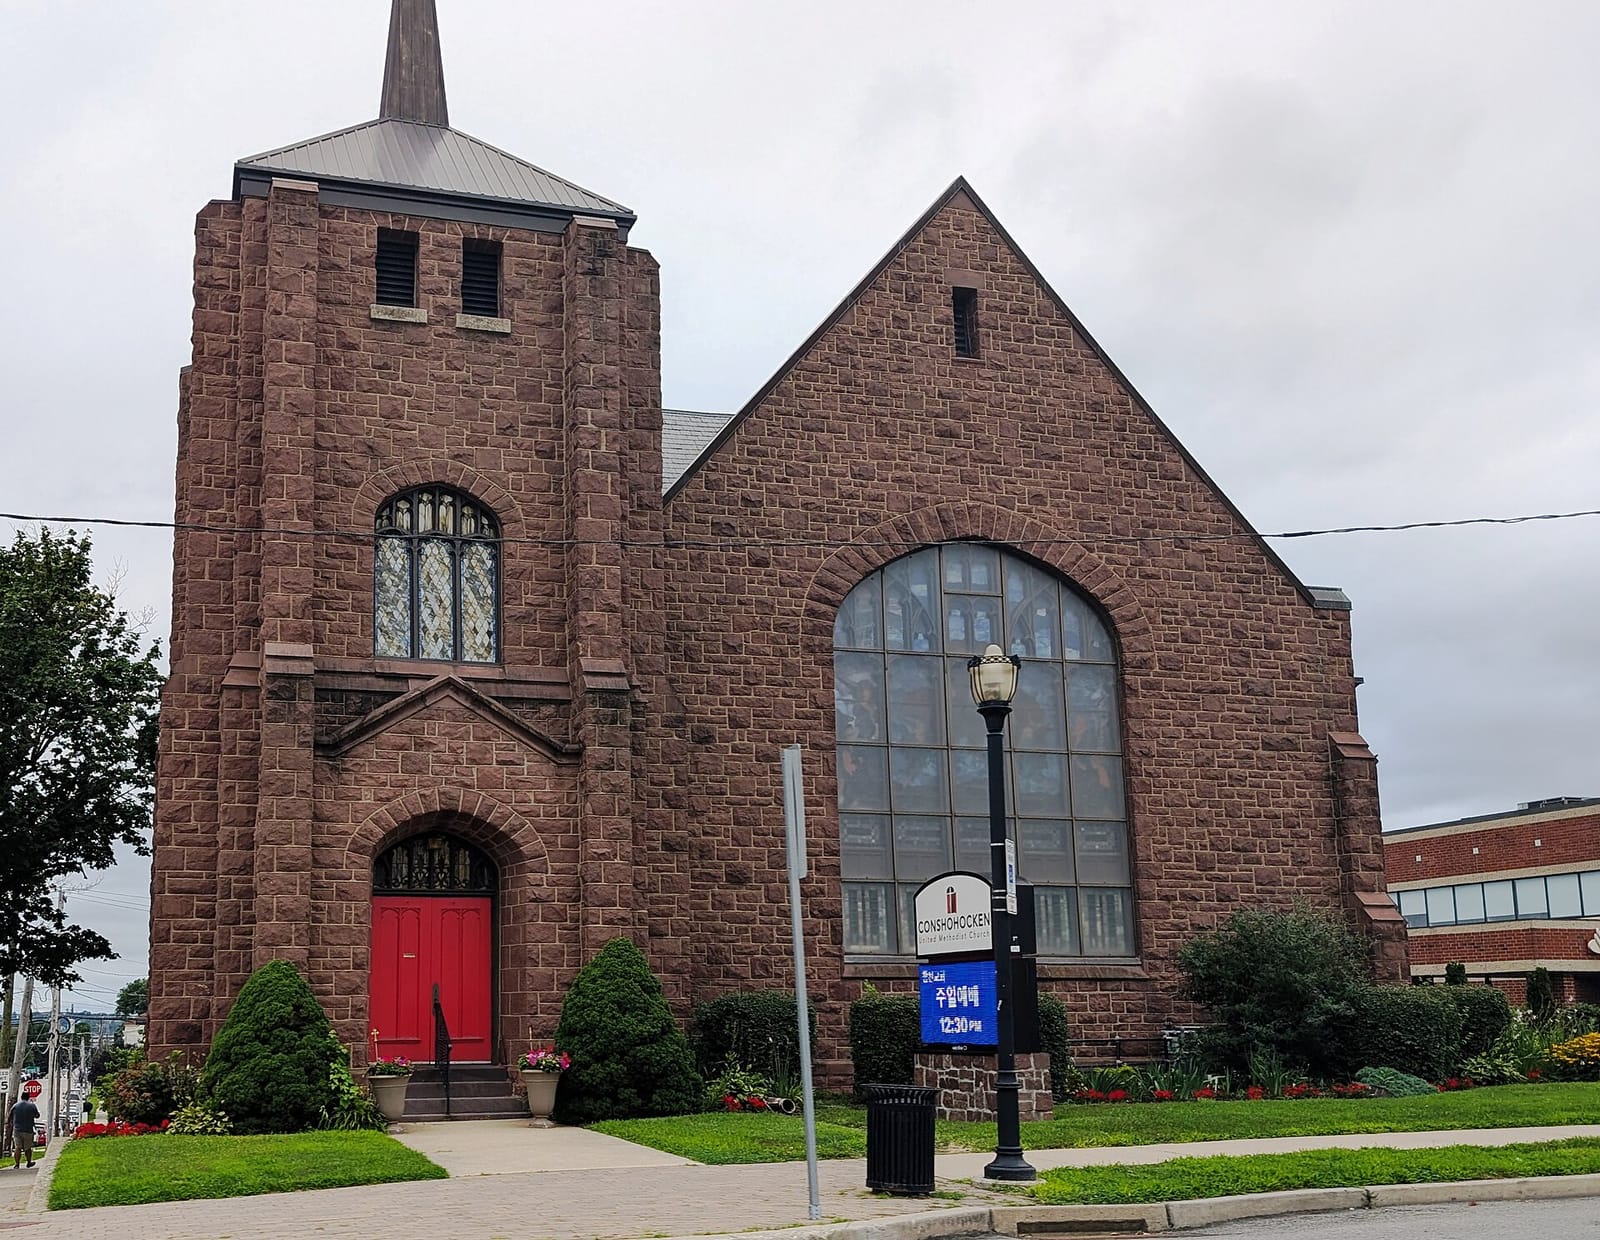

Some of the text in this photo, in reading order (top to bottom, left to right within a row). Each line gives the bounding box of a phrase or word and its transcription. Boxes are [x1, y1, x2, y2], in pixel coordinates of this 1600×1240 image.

[918, 912, 990, 933] CONSHOHOCKEN
[919, 930, 990, 944] United Methodist Church
[935, 984, 979, 1008] 주일예배
[938, 1016, 982, 1033] 12:30 PM
[1, 1081, 8, 1090] 5
[24, 1085, 41, 1093] STOP
